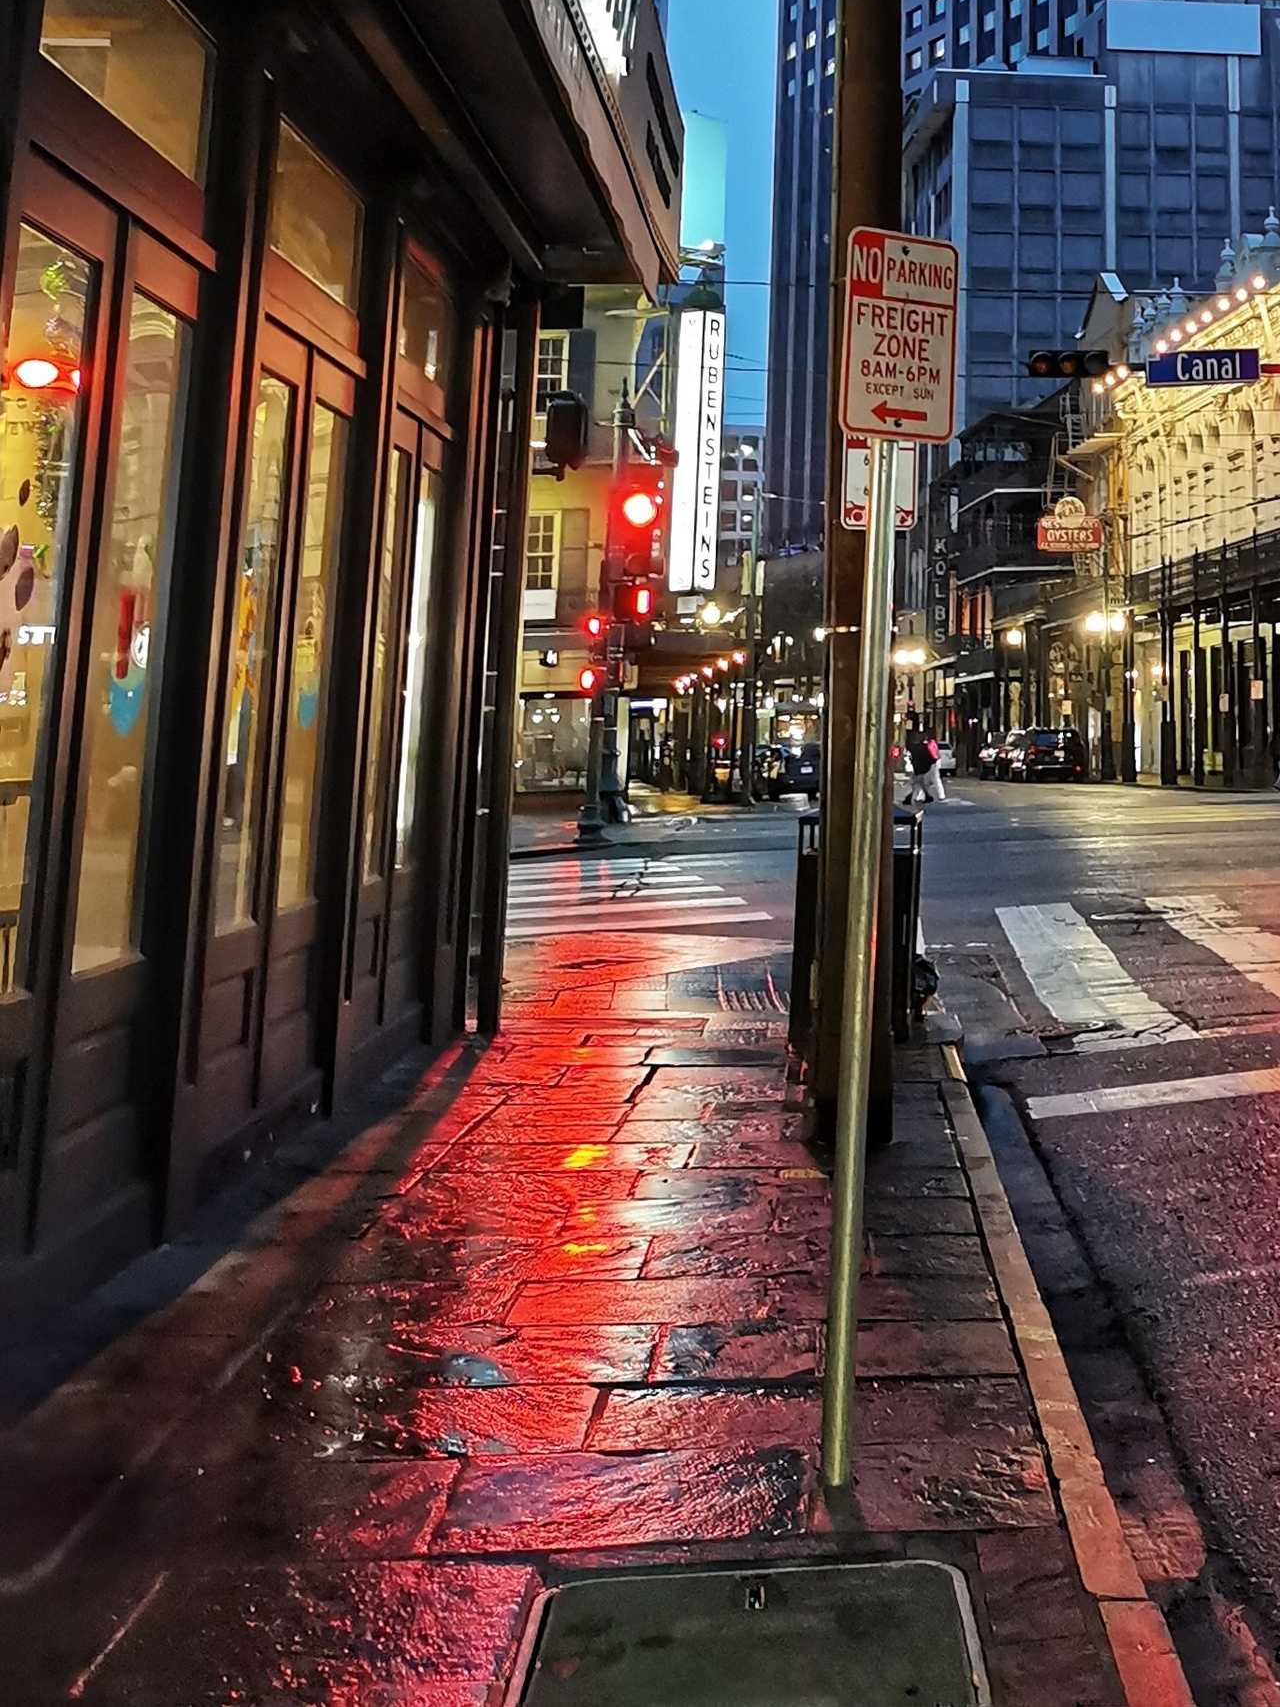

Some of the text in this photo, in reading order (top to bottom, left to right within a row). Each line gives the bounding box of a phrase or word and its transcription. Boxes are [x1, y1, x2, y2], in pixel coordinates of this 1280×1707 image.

[853, 245, 953, 290] NO PARKING
[857, 302, 949, 336] FREIGHT
[873, 333, 930, 362] ZONE
[860, 359, 941, 386] 8AM-6PM
[1176, 352, 1241, 381] Canal
[865, 382, 934, 401] EXCEPT SUN
[700, 318, 721, 578] RUBENSTEINS
[1046, 529, 1094, 542] OYSTERS
